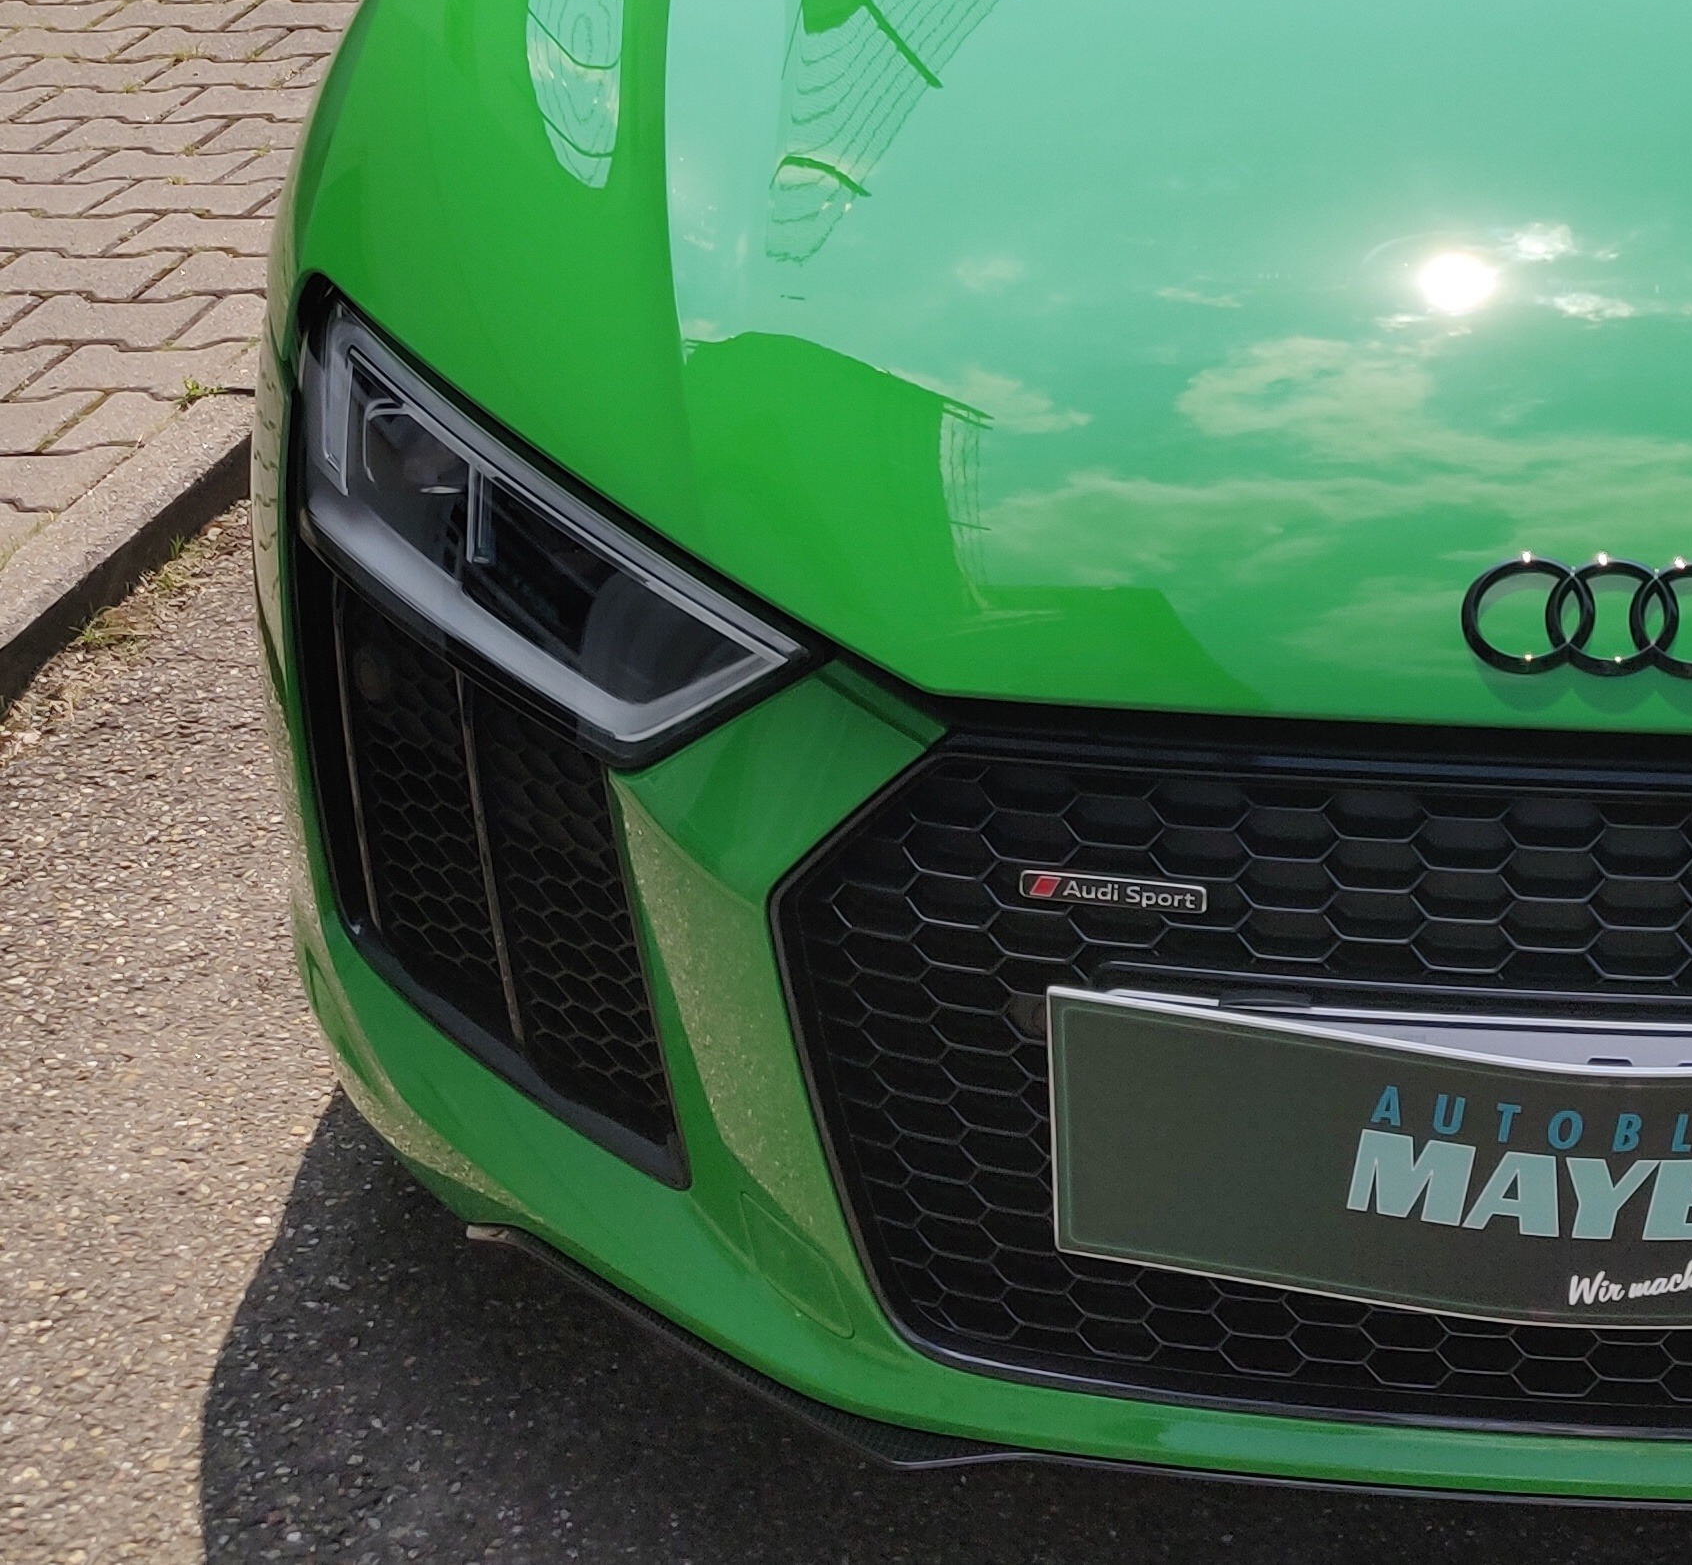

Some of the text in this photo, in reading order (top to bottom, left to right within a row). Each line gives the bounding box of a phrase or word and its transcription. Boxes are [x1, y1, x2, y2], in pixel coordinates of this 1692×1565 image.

[1062, 880, 1196, 909] Audi Sport
[1568, 1271, 1626, 1306] Wir
